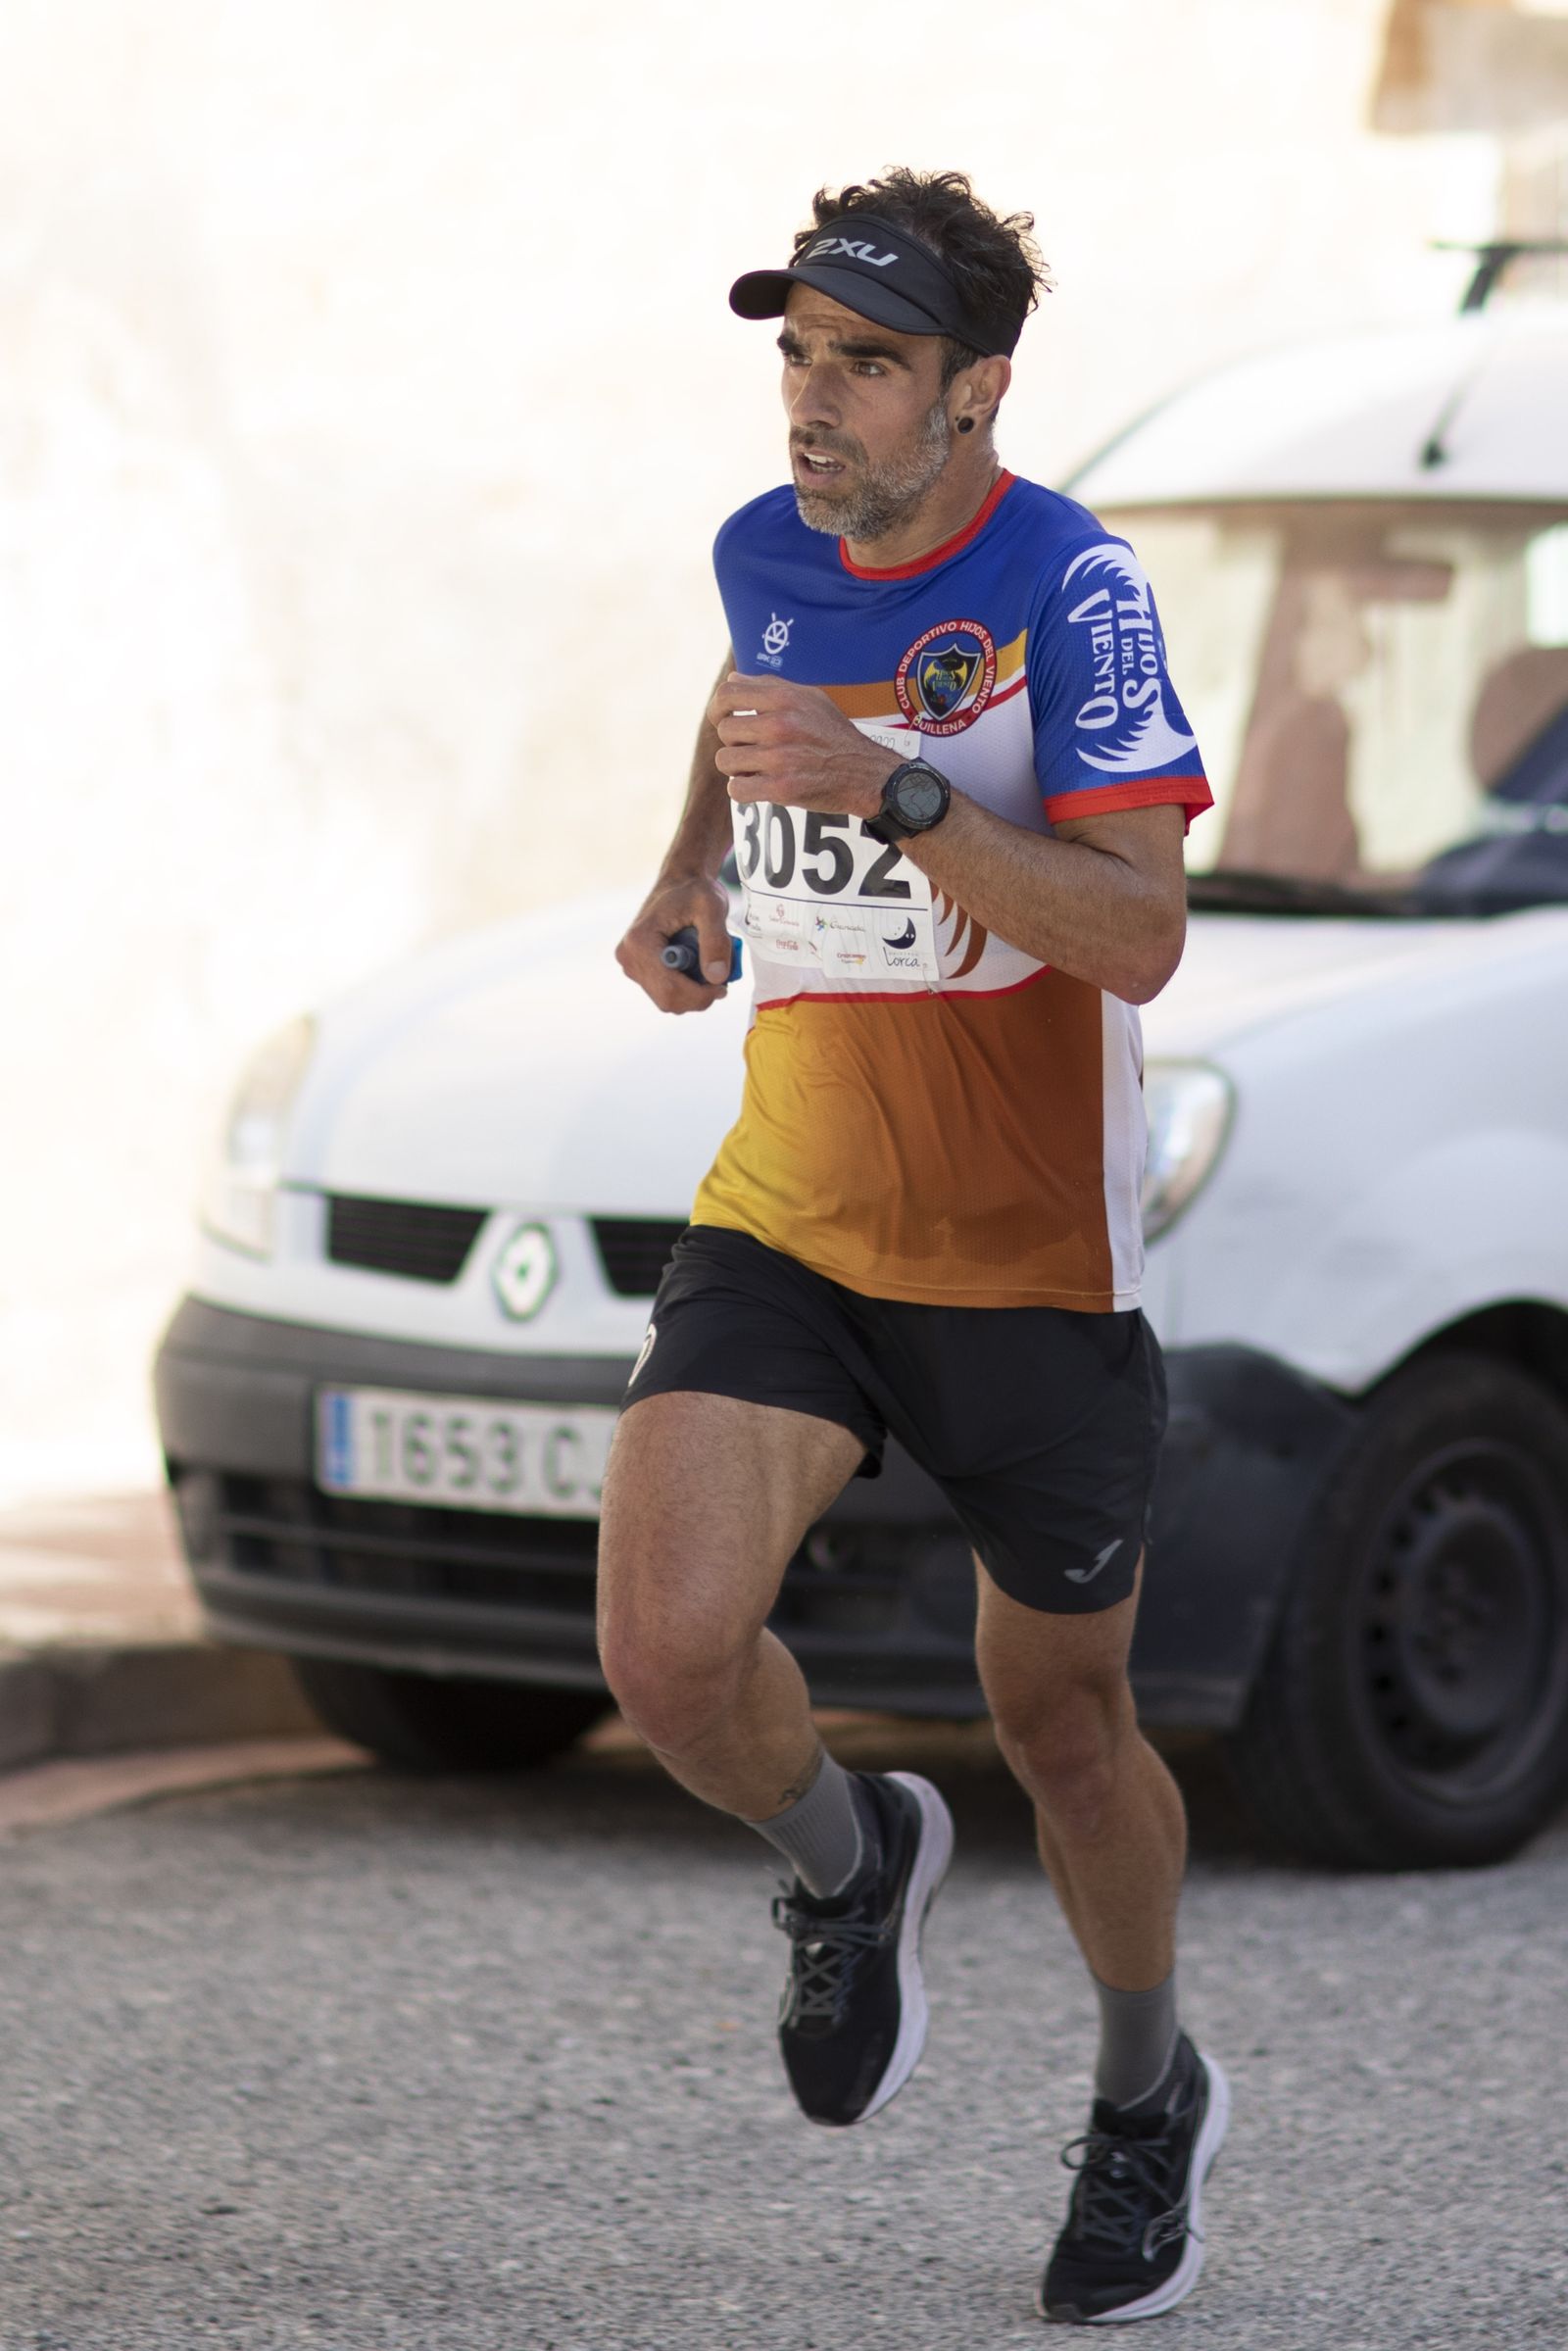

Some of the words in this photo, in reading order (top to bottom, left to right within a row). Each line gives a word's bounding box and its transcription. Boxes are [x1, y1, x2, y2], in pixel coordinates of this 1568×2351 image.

[806, 238, 899, 267] 2XU
[899, 621, 957, 673] DEPORTIVO
[959, 620, 987, 640] HIJOS
[982, 639, 995, 661] DEL
[1067, 588, 1119, 729] VIENTO
[1121, 637, 1135, 675] DEL
[896, 677, 910, 710] CLUB
[972, 665, 996, 713] VIENTO
[737, 802, 911, 899] 3052
[883, 947, 920, 967] Lorca
[371, 1411, 522, 1494] 1653
[542, 1424, 603, 1501] C
